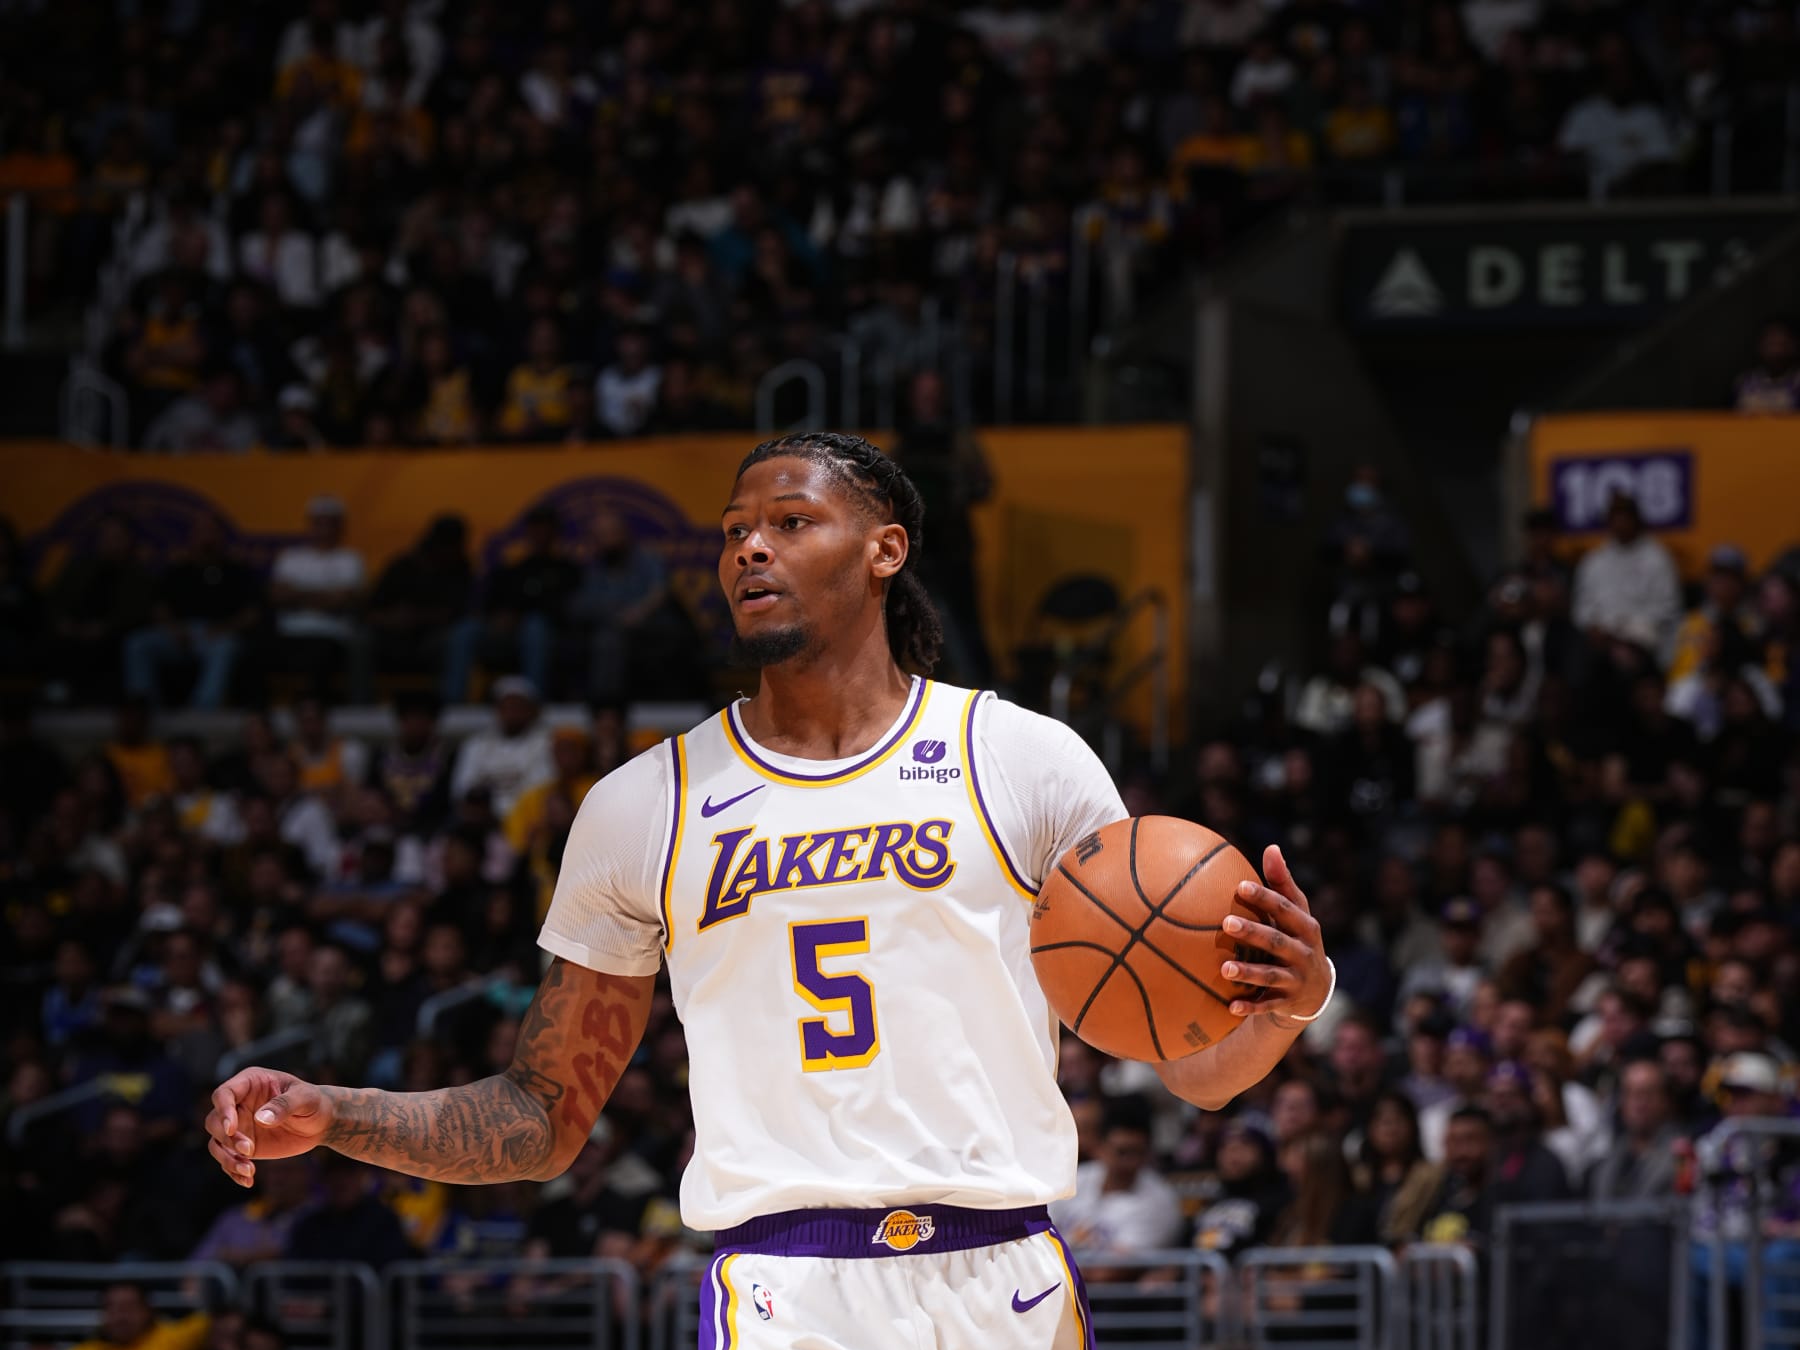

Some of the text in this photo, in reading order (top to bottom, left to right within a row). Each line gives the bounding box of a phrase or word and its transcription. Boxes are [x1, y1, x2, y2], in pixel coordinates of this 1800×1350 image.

[899, 766, 961, 784] bibigo
[697, 818, 957, 932] LAKERS
[788, 915, 881, 1073] 5
[875, 1221, 935, 1241] LAKERS
